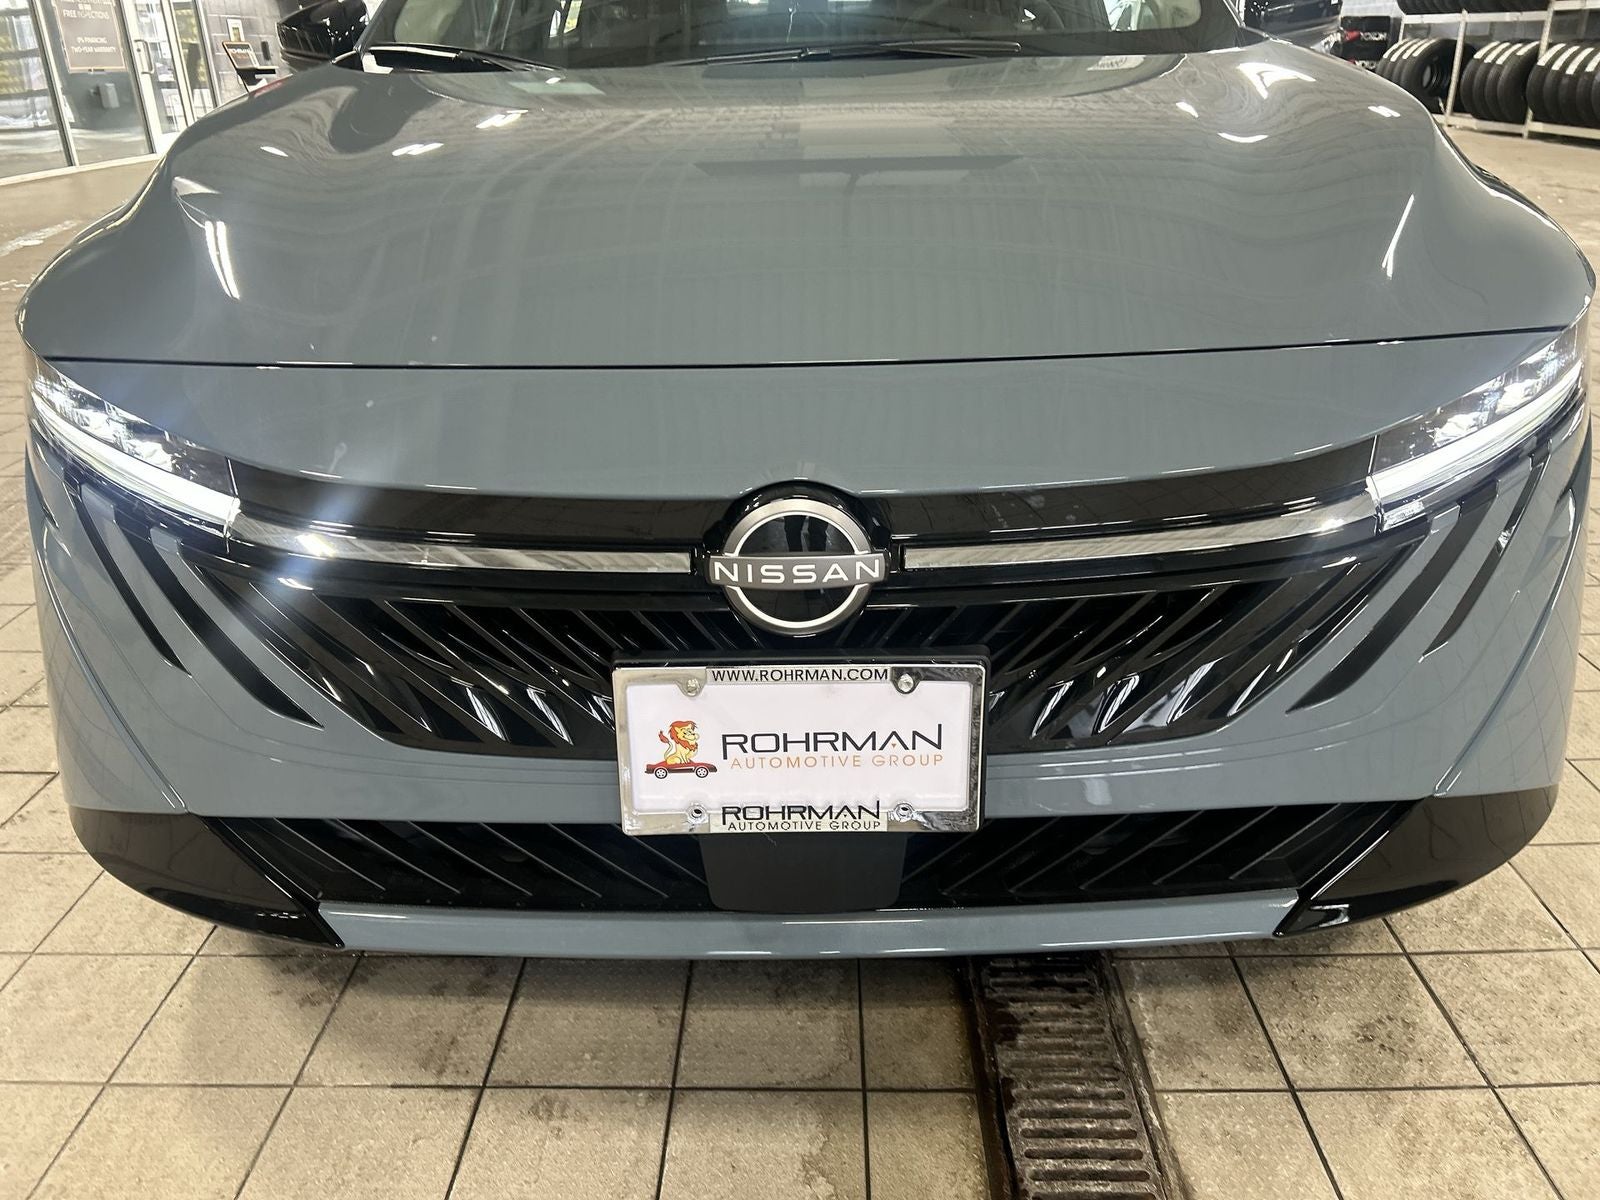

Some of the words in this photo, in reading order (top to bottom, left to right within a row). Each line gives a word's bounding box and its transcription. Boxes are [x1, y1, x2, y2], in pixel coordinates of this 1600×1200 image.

[713, 559, 880, 584] NISSAN
[712, 668, 888, 682] WWW.ROHRMAN.COM
[721, 723, 943, 760] ROHRMAN
[730, 755, 862, 769] AUTOMOTIVE
[872, 754, 944, 767] GROUP
[722, 800, 880, 825] ROHRMAN
[728, 821, 822, 831] AUTOMOTIVE
[830, 820, 881, 830] GROUP
